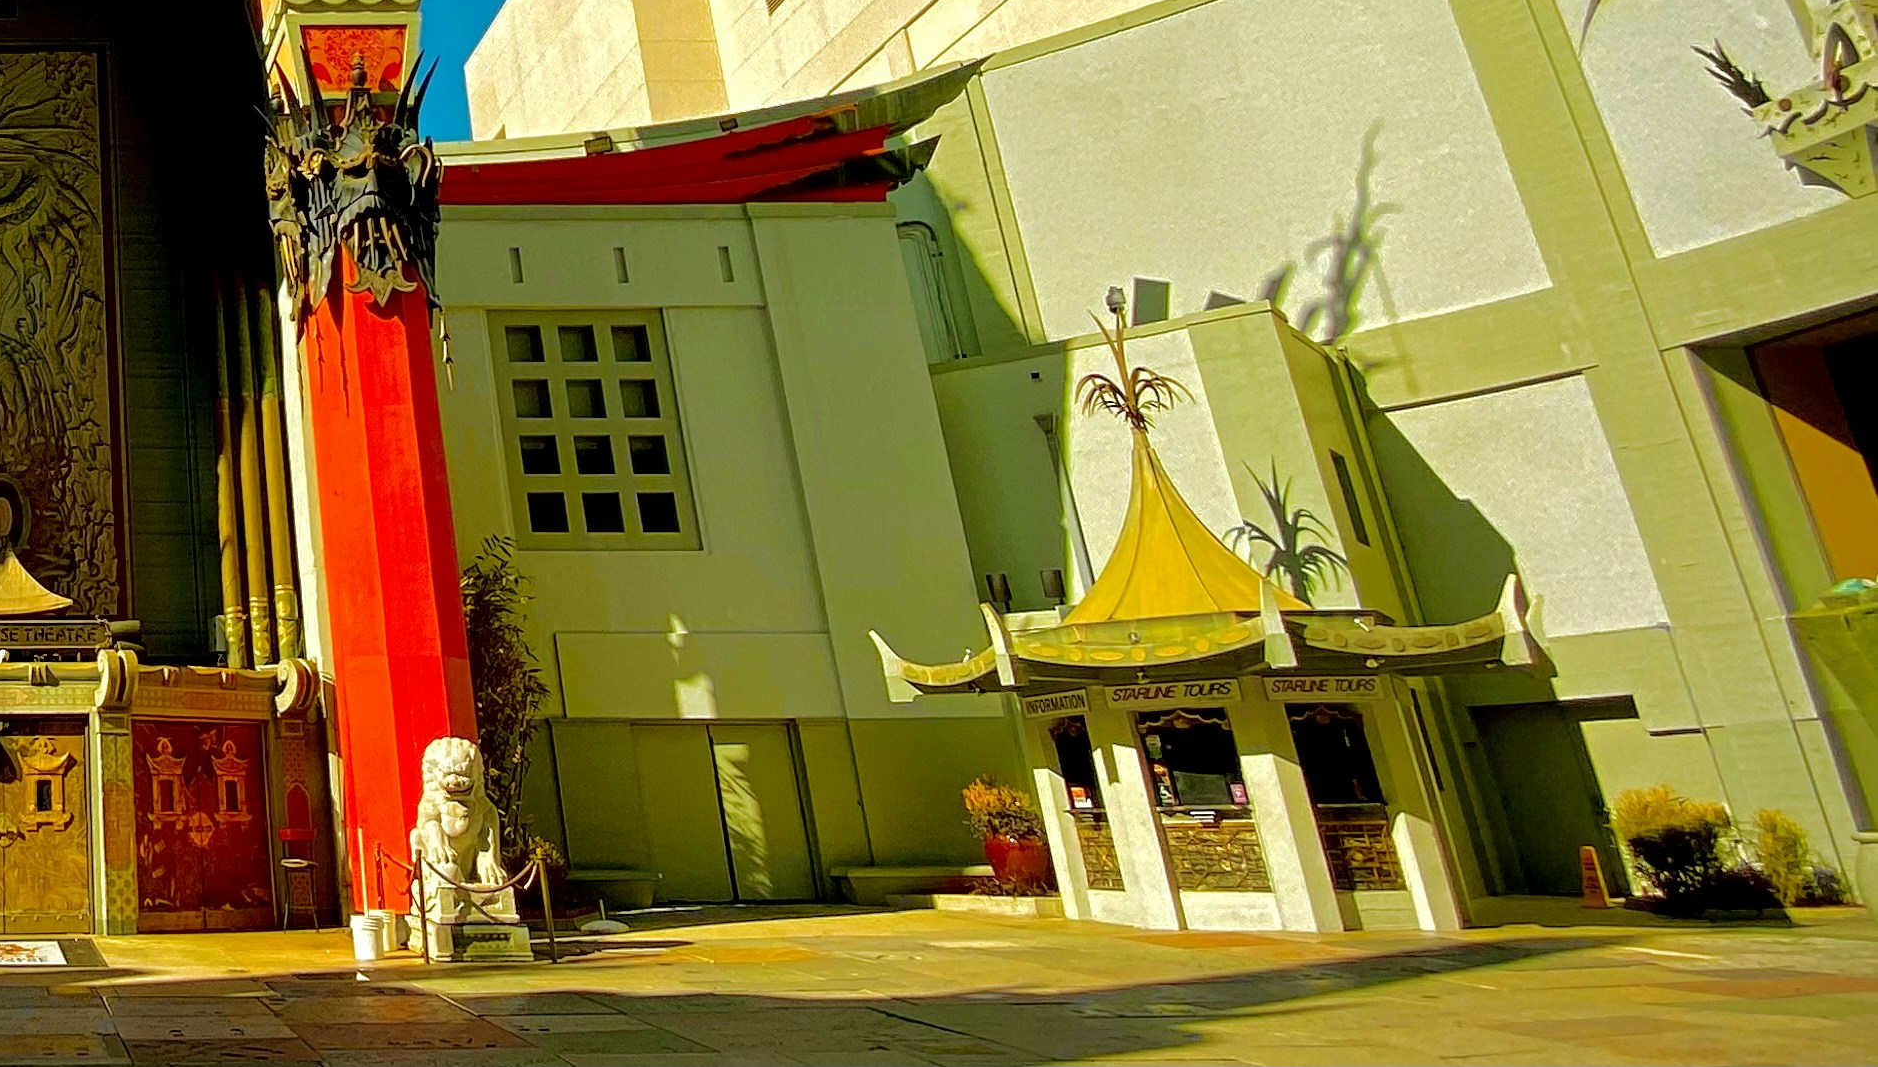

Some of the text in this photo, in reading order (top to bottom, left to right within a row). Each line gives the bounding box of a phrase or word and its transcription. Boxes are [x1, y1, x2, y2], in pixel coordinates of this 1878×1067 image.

[25, 626, 98, 643] THEATRE
[1112, 682, 1232, 702] STARLINE TOURS
[1272, 678, 1376, 693] STARLINE TOURS
[1026, 694, 1086, 715] INFORMATION
